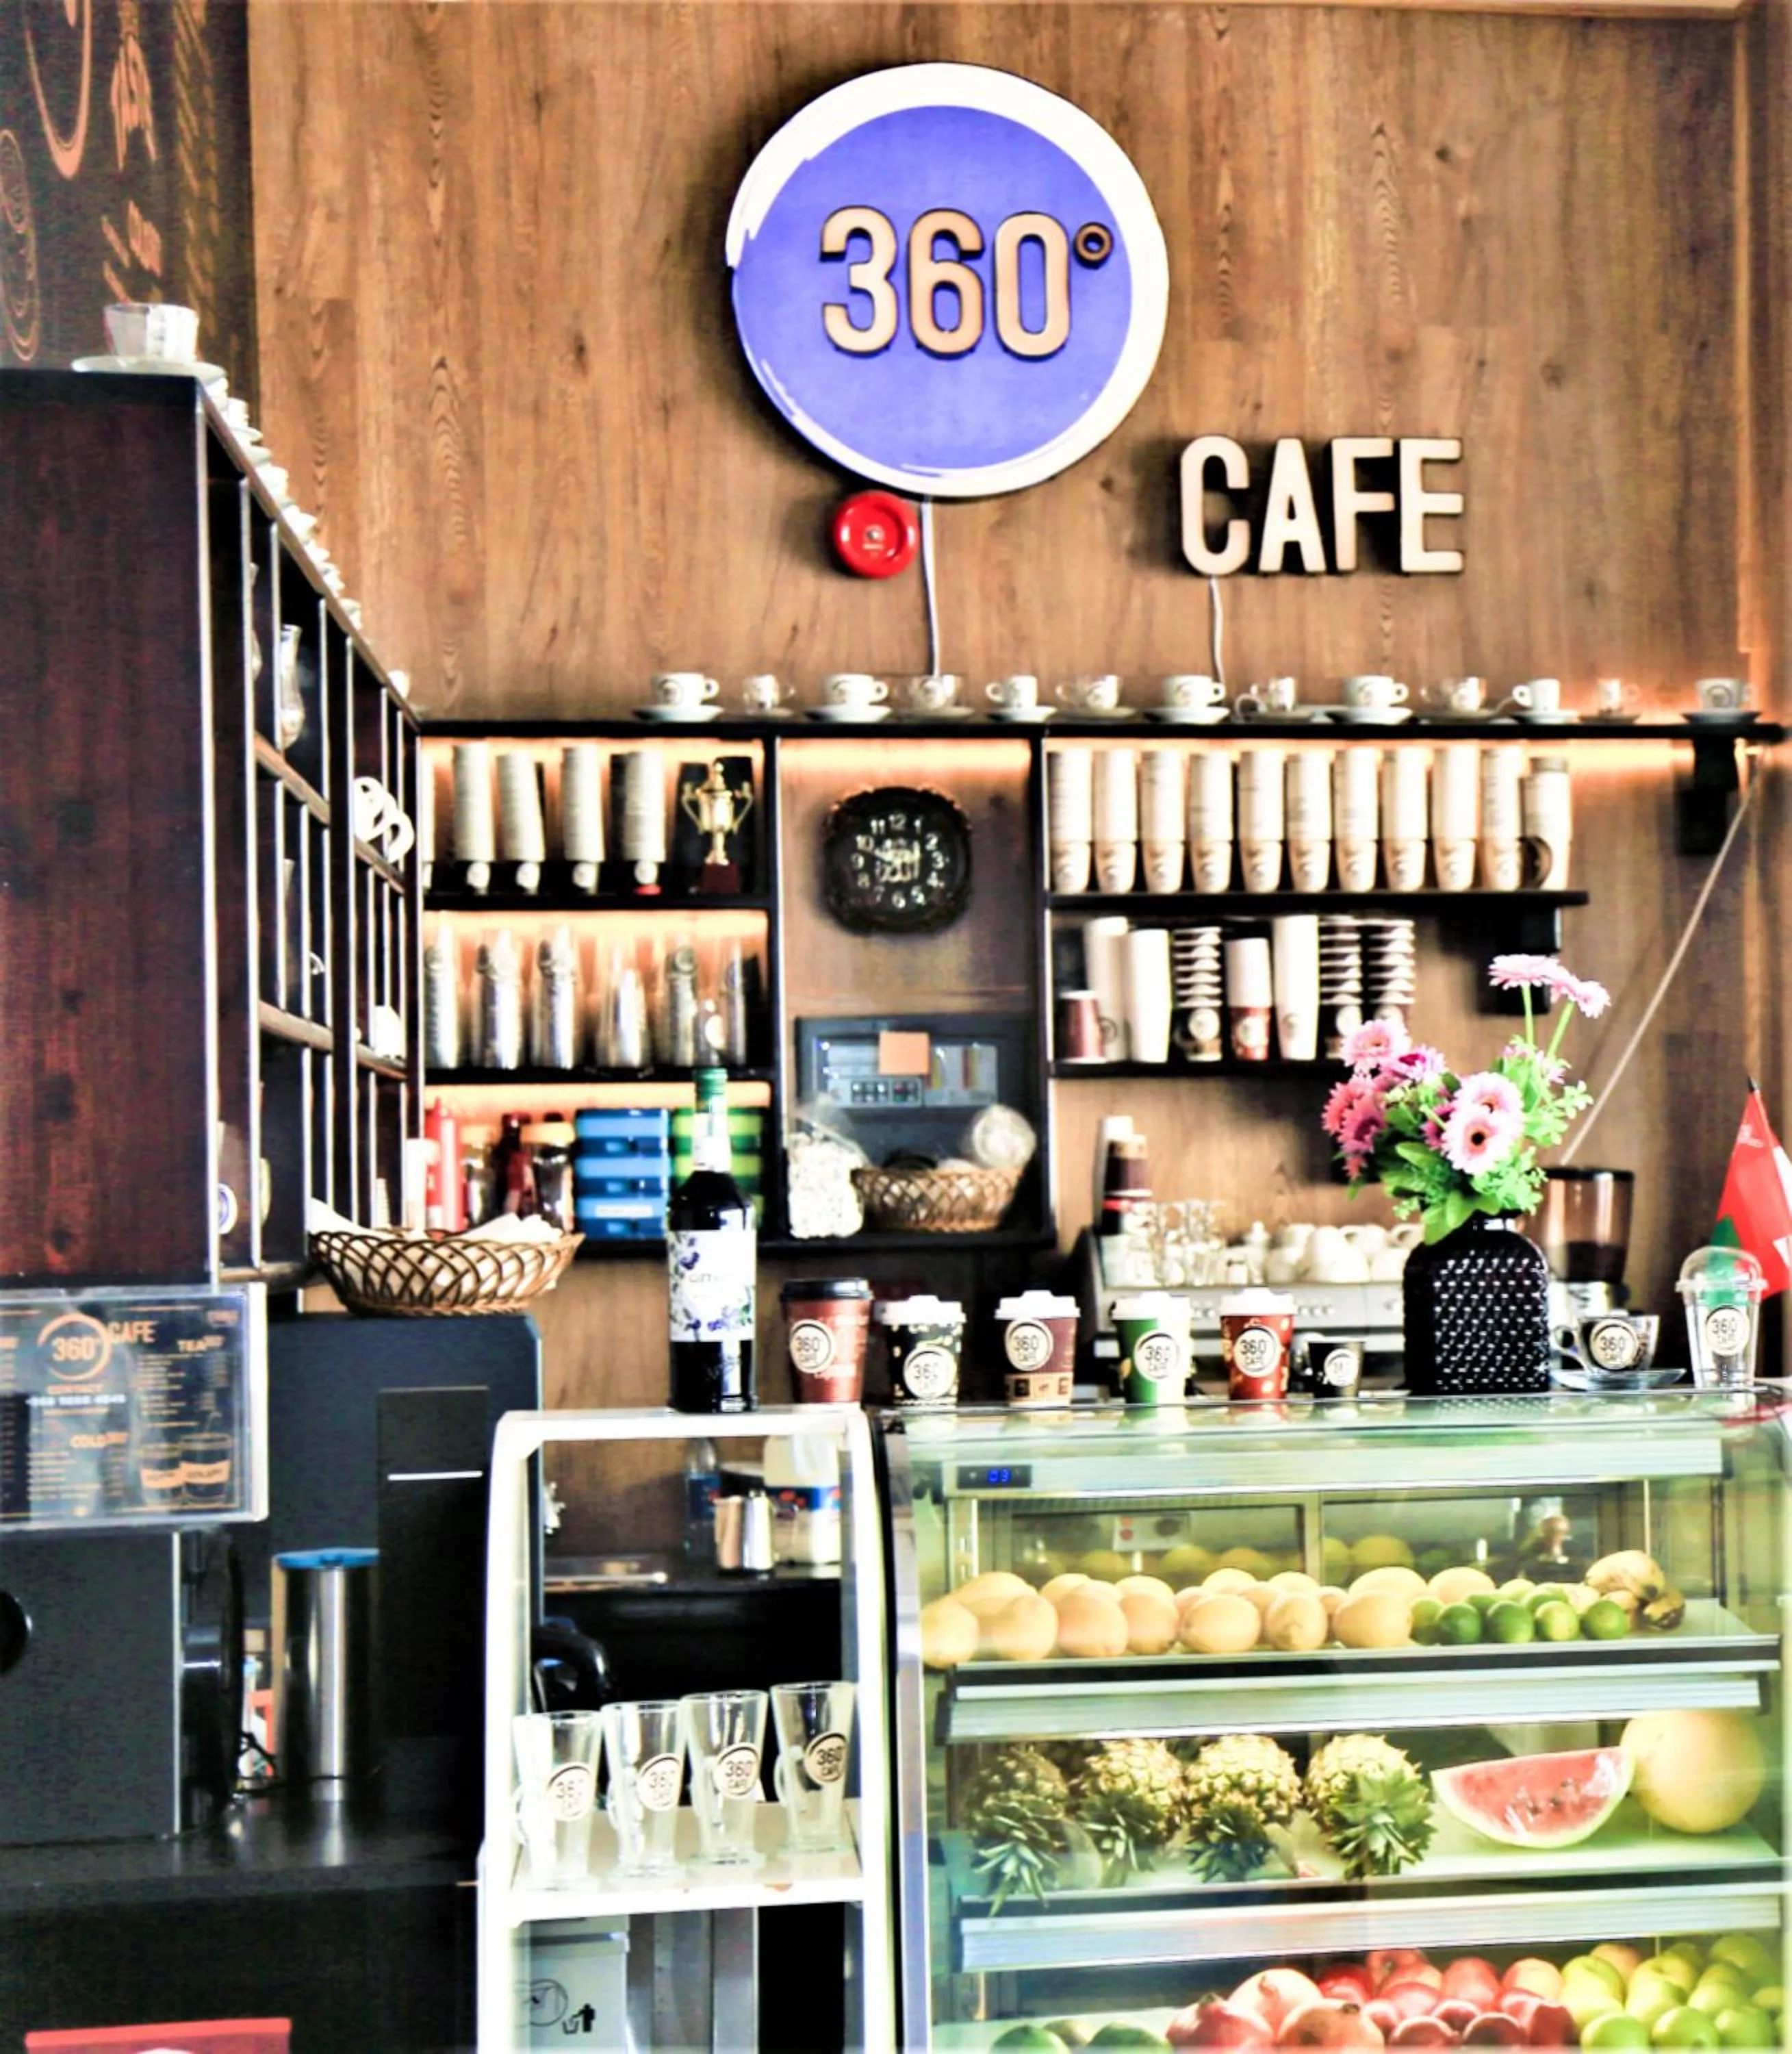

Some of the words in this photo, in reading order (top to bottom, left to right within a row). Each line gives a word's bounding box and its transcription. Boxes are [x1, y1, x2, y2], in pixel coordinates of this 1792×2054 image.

[1179, 435, 1464, 576] CAFE
[889, 813, 906, 831] 12
[925, 833, 938, 851] 2
[932, 851, 945, 869] 3
[892, 892, 906, 909] 6
[107, 1321, 158, 1344] CAFE
[1240, 1339, 1267, 1355] 360
